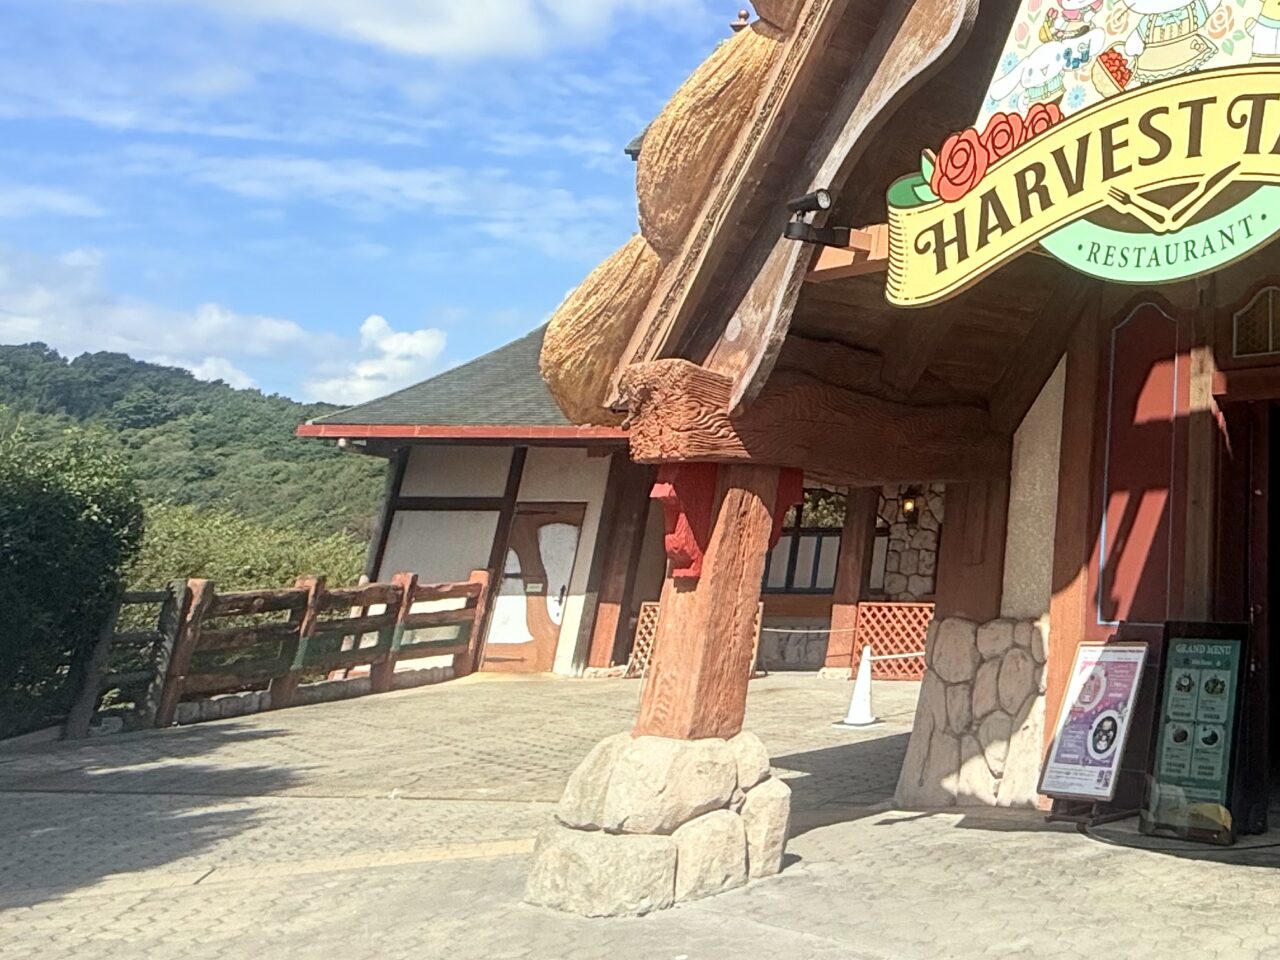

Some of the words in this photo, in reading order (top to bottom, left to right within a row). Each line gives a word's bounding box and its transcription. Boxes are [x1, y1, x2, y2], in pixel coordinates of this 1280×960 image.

[914, 96, 1217, 274] HARVEST
[1086, 213, 1253, 269] RESTAURANT
[1175, 644, 1206, 654] GRAND
[1206, 645, 1232, 655] MENU
